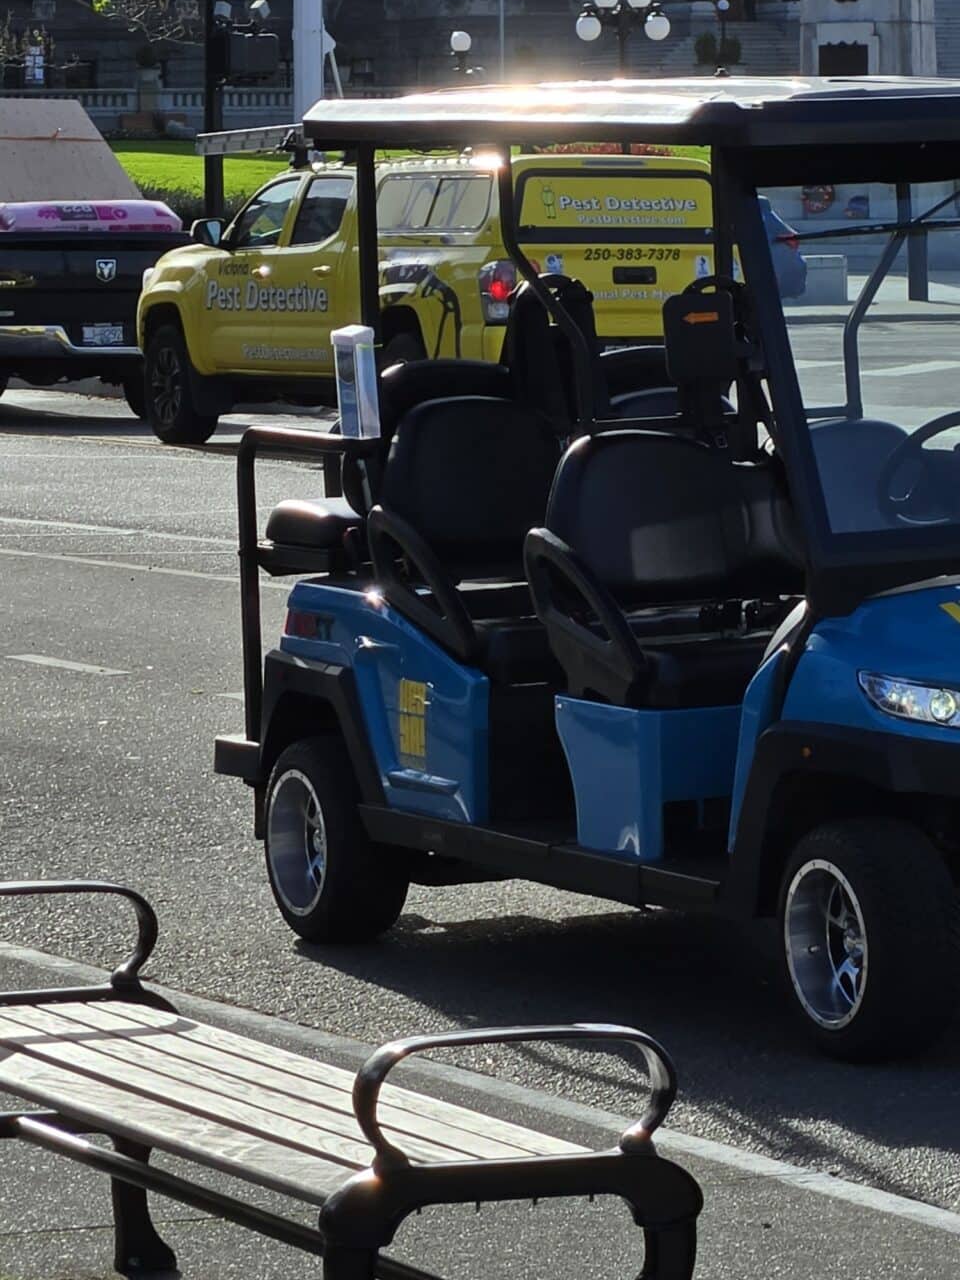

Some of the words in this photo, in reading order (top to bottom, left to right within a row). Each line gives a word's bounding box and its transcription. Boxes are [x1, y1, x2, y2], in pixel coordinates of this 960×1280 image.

[558, 195, 601, 211] Pest
[605, 196, 697, 212] Detective
[583, 248, 681, 261] 250-383-7378
[206, 280, 241, 310] Pest
[244, 281, 328, 312] Detective
